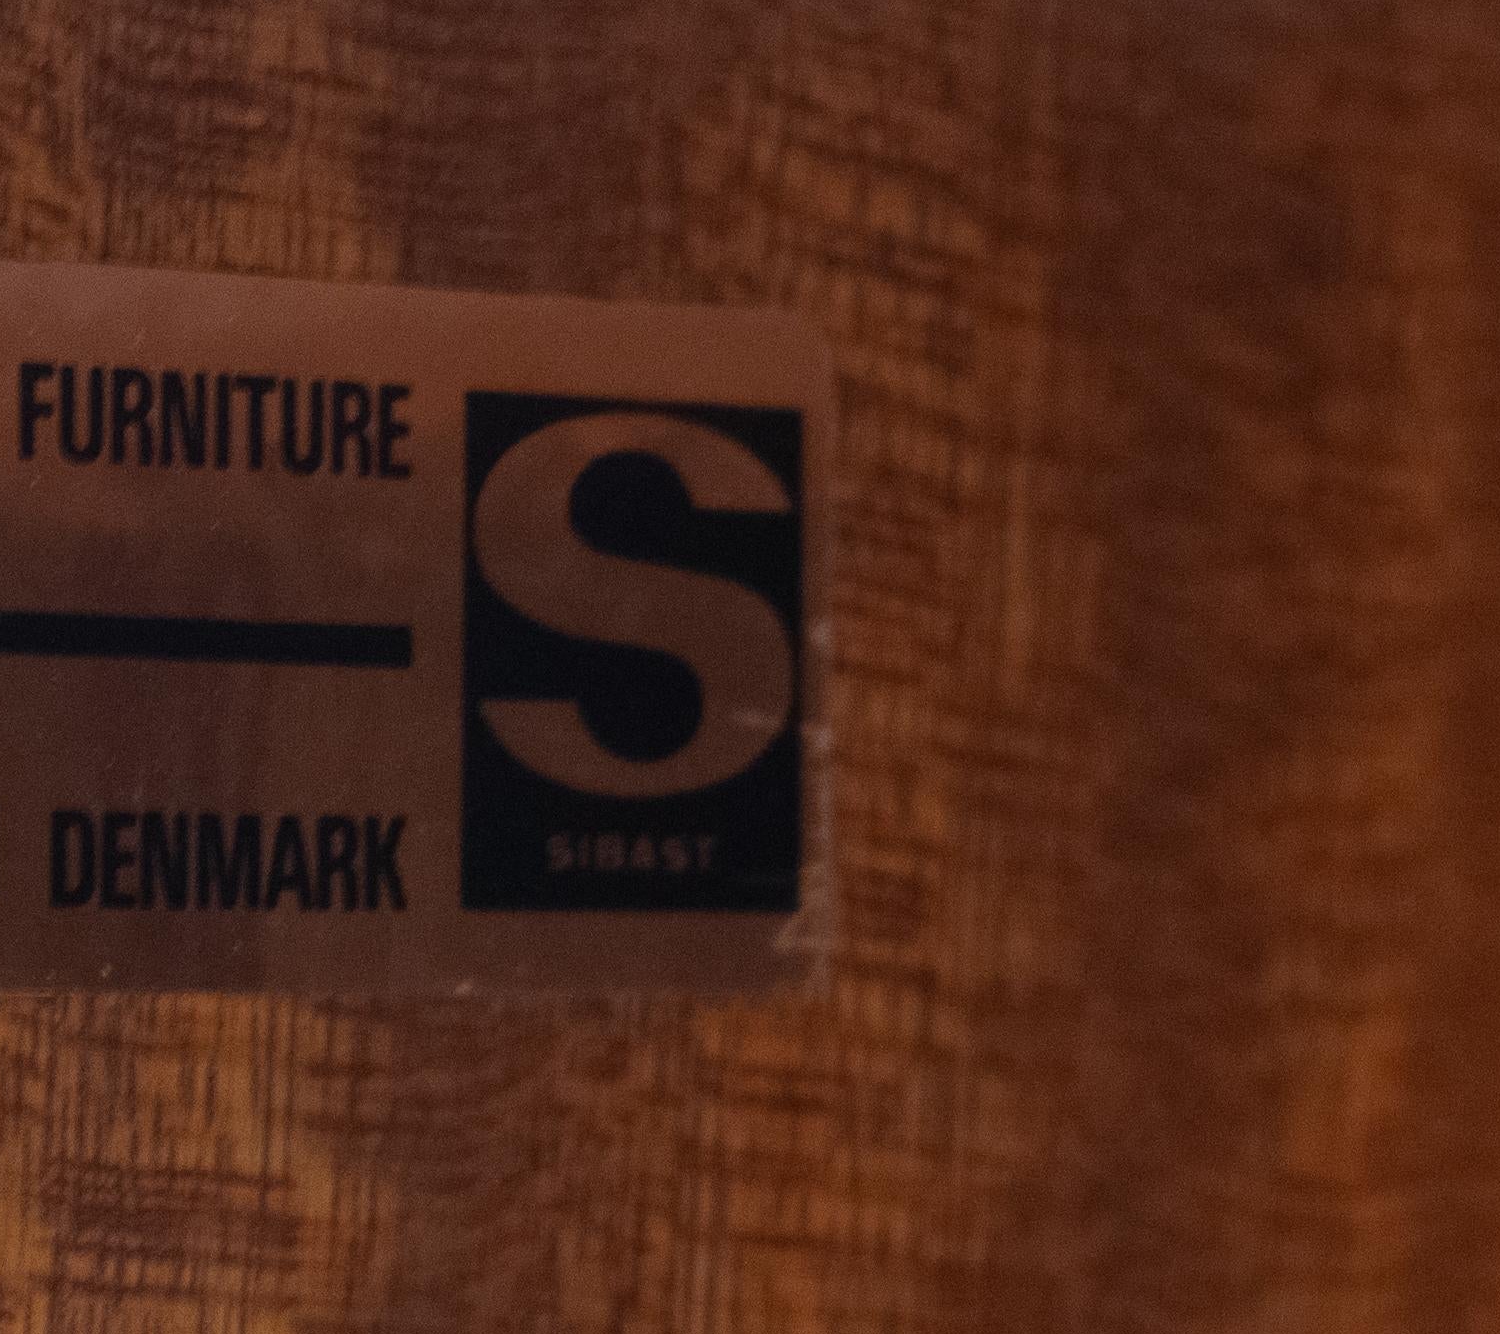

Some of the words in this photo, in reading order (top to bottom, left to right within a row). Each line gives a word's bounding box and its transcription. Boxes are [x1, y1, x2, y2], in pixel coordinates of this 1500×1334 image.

[17, 361, 414, 482] FURNITURE
[474, 411, 796, 798] S
[48, 808, 410, 912] DENMARK
[546, 833, 718, 872] SIBAST
